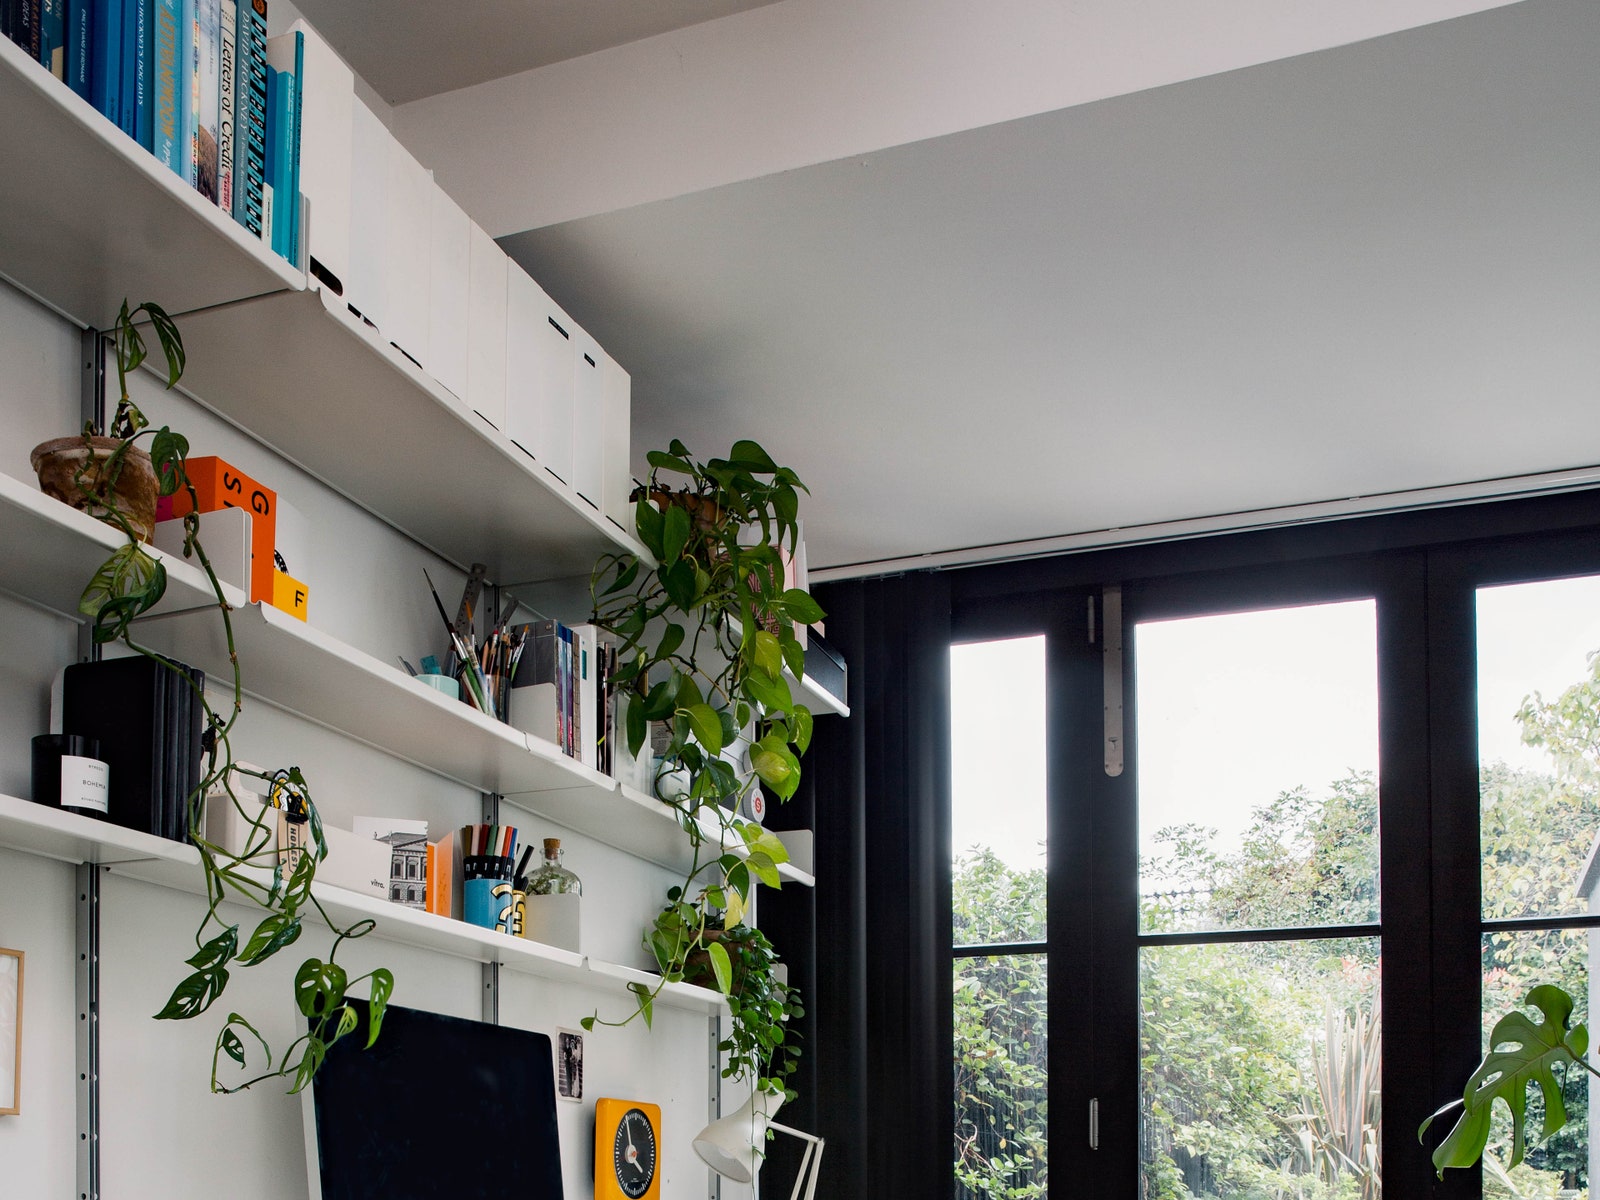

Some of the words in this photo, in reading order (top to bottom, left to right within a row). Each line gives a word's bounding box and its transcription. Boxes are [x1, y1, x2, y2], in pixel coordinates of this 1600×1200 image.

[242, 10, 250, 56] DAVID
[253, 22, 263, 86] HANDBOOK
[160, 4, 174, 141] MOOMINVALLEY
[222, 38, 234, 94] Letters
[221, 97, 233, 119] of
[240, 58, 248, 134] HOCKNEY
[221, 121, 232, 170] Credit
[252, 490, 269, 516] G
[295, 590, 304, 608] F
[82, 780, 106, 789] BOHEMIA
[290, 827, 299, 869] HONEST
[370, 879, 385, 889] vitra.
